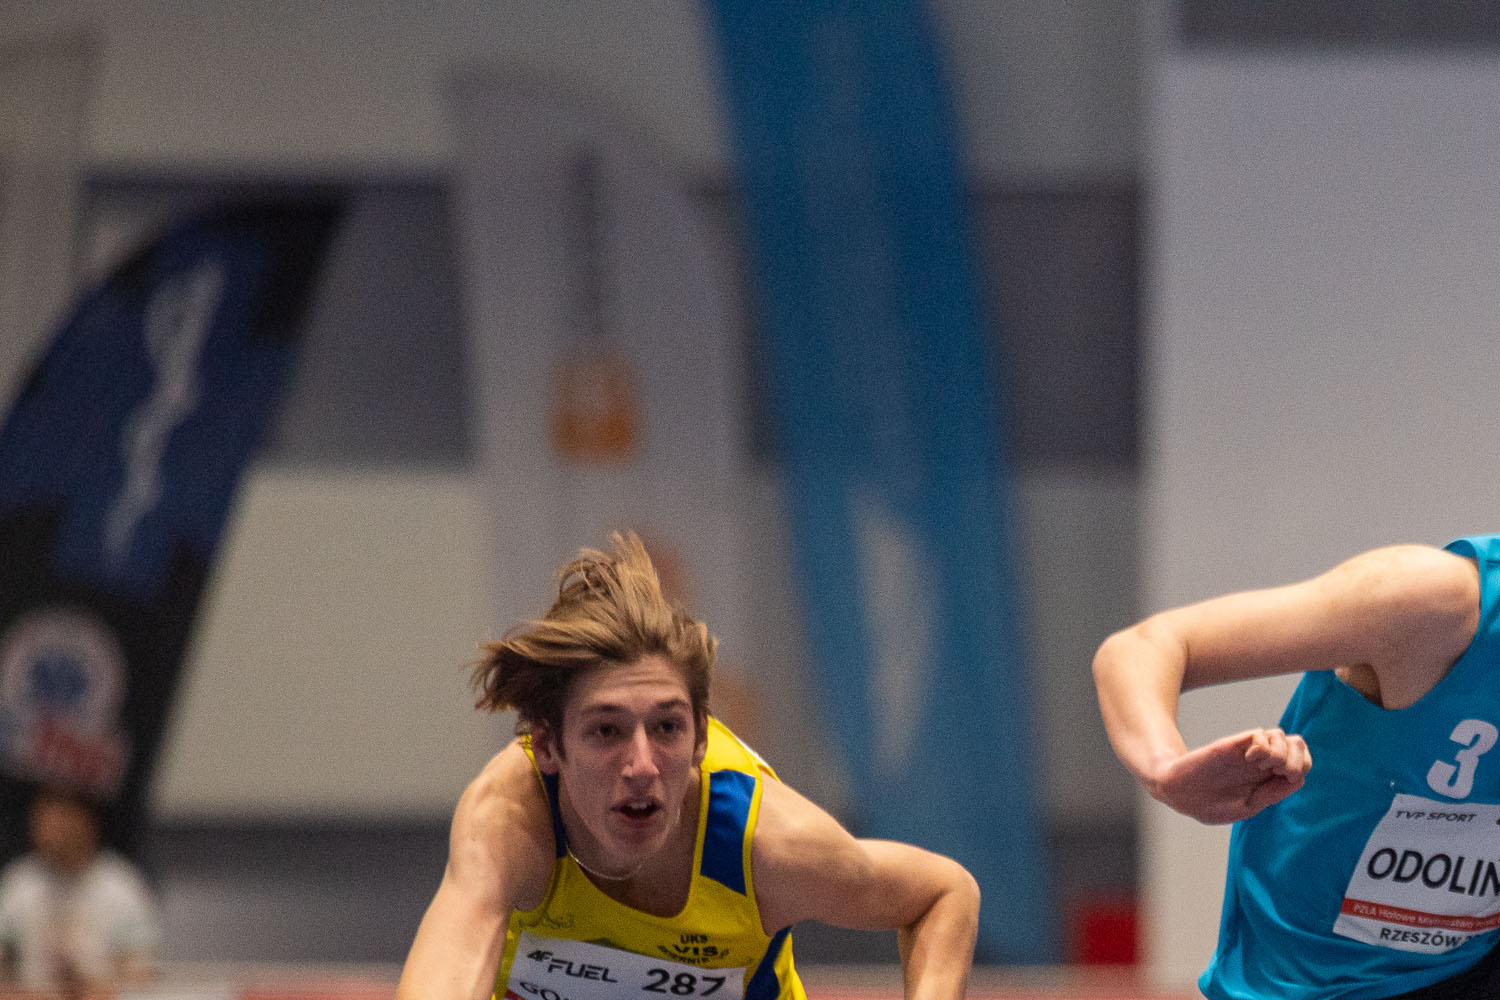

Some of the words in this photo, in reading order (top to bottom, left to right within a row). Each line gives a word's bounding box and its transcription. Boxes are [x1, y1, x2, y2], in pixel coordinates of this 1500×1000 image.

[1426, 719, 1499, 800] 3
[1395, 810, 1426, 820] TVP
[1427, 812, 1478, 823] SPORT
[1379, 927, 1462, 948] RZESZÓW
[642, 968, 726, 998] 287
